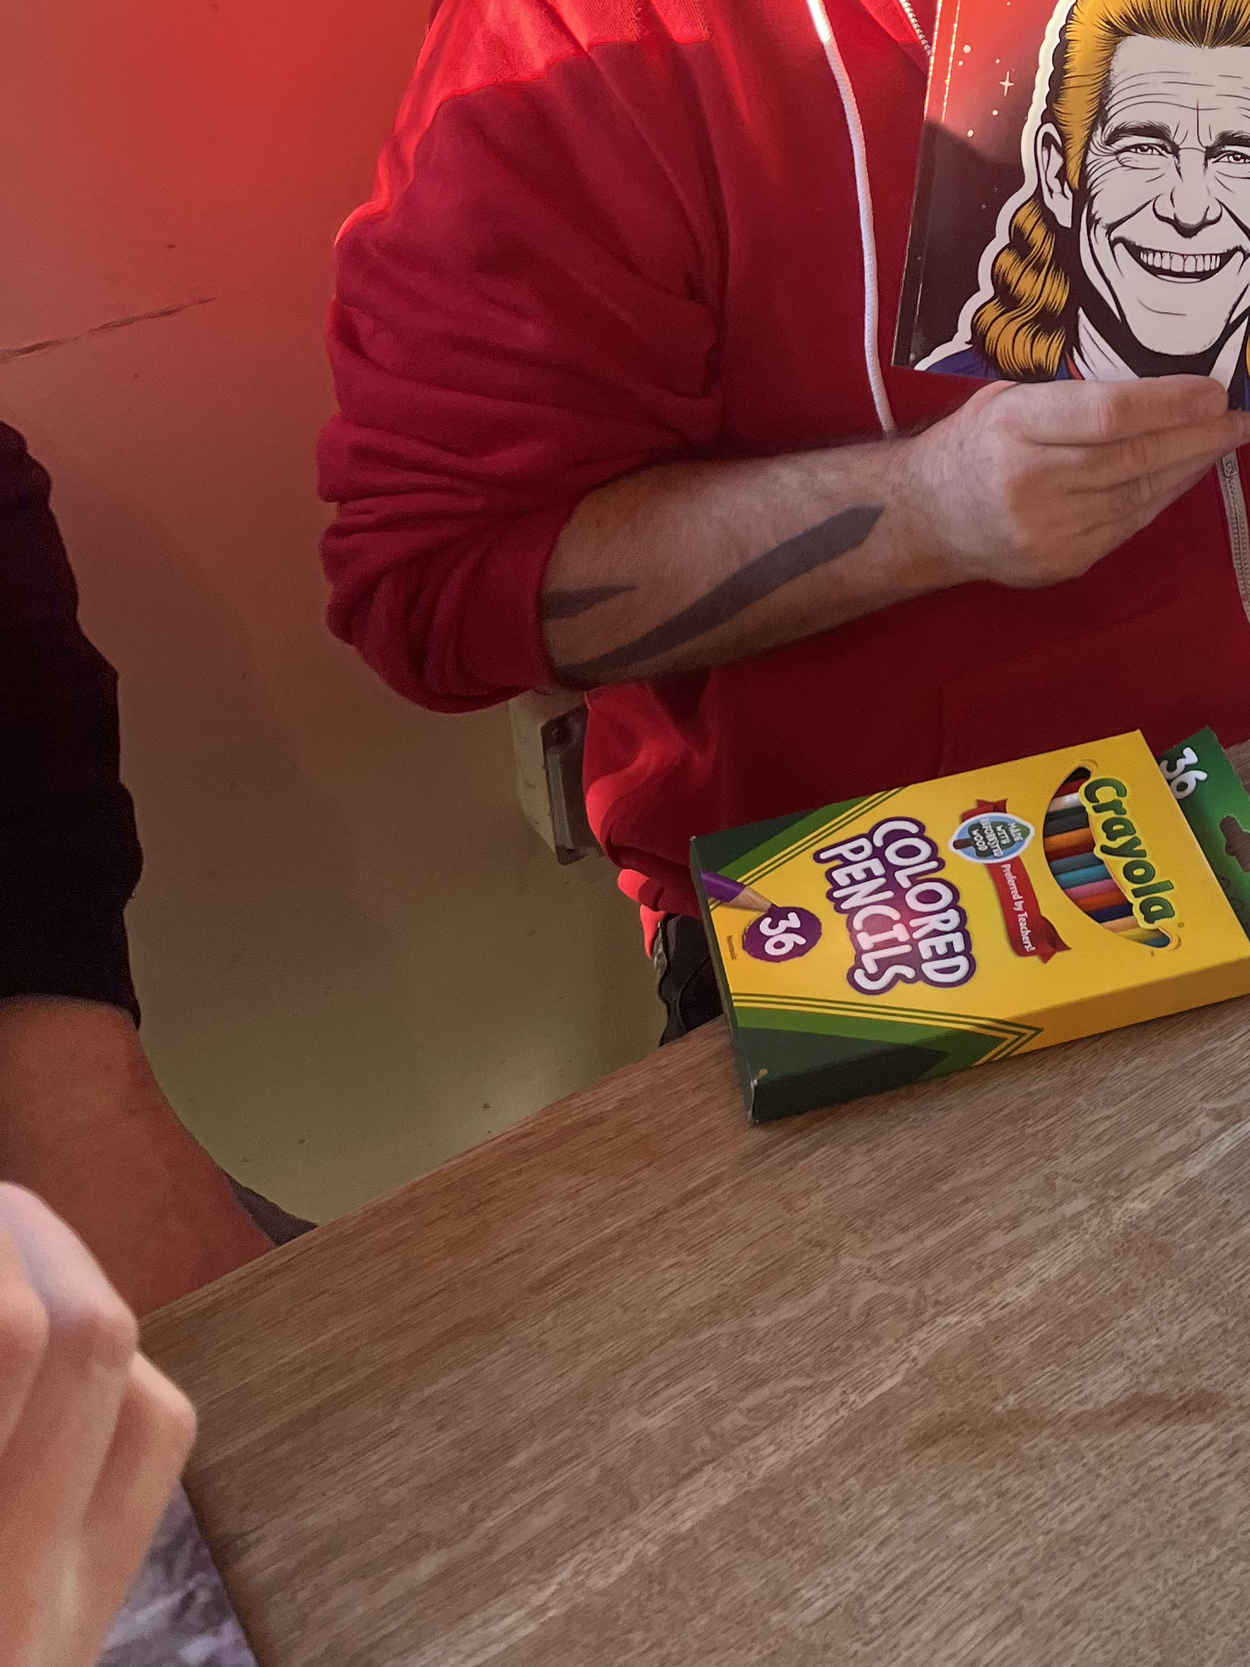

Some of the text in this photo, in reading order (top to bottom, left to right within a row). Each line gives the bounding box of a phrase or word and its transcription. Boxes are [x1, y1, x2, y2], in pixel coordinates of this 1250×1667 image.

[1160, 747, 1208, 799] 36
[971, 828, 989, 852] WOOD
[996, 824, 1012, 845] WITH
[1007, 821, 1024, 842] MADE
[1084, 777, 1176, 924] Crayola
[820, 837, 916, 990] PENCILS
[873, 820, 970, 983] COLORED
[1001, 863, 1036, 952] Preferred by Teachers!
[759, 912, 807, 956] 36
